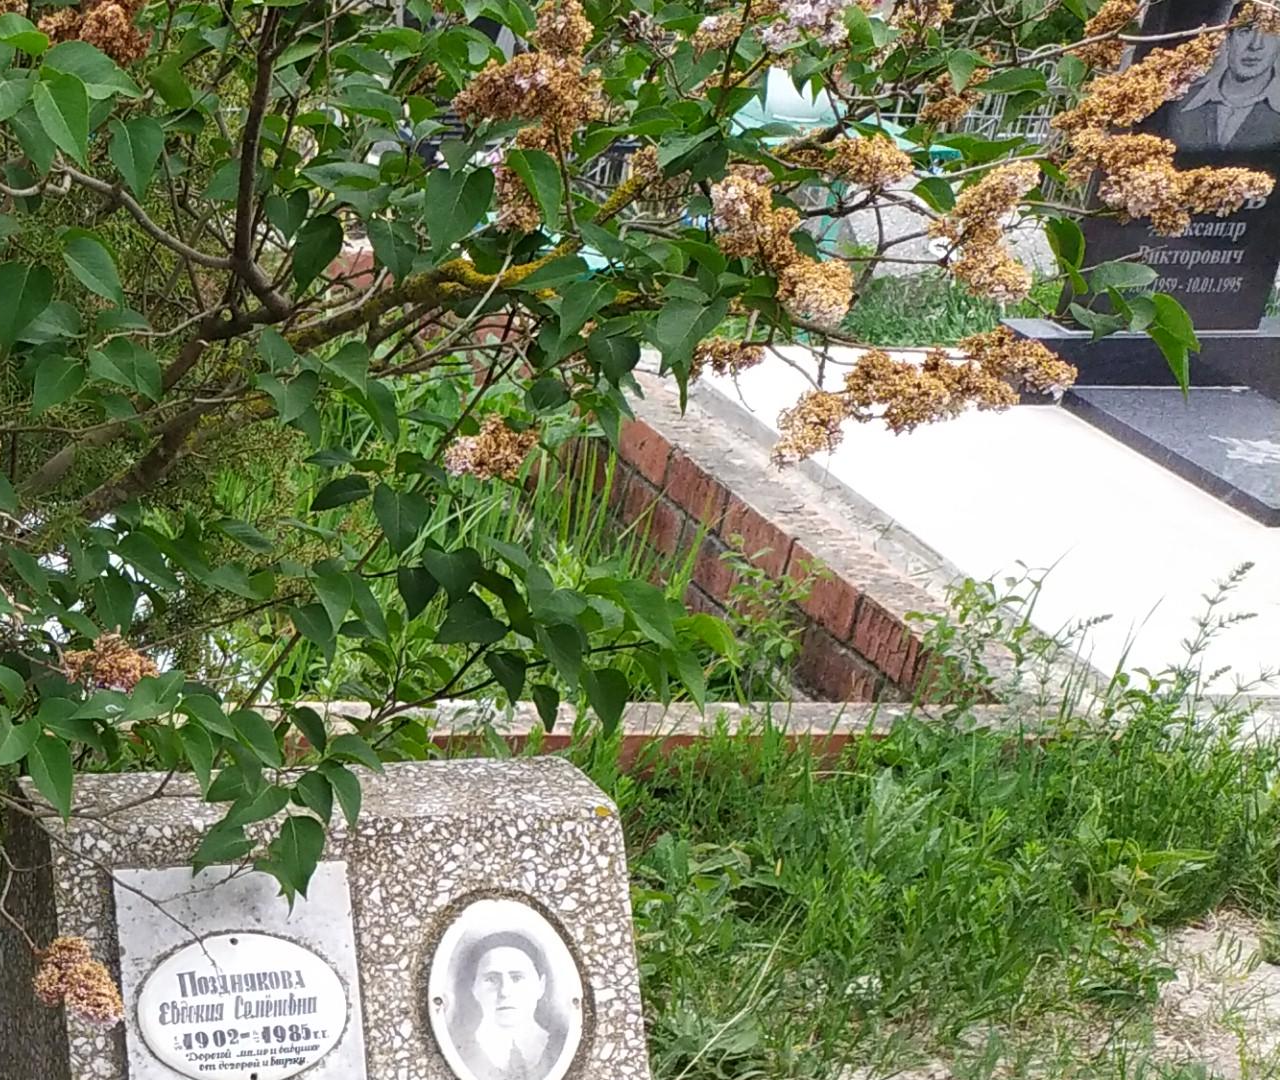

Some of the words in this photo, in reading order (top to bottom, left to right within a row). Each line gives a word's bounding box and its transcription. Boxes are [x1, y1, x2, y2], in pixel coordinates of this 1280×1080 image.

[1146, 221, 1247, 242] ксандр
[1137, 244, 1244, 269] Викторович
[1185, 276, 1244, 293] 10.01.1995
